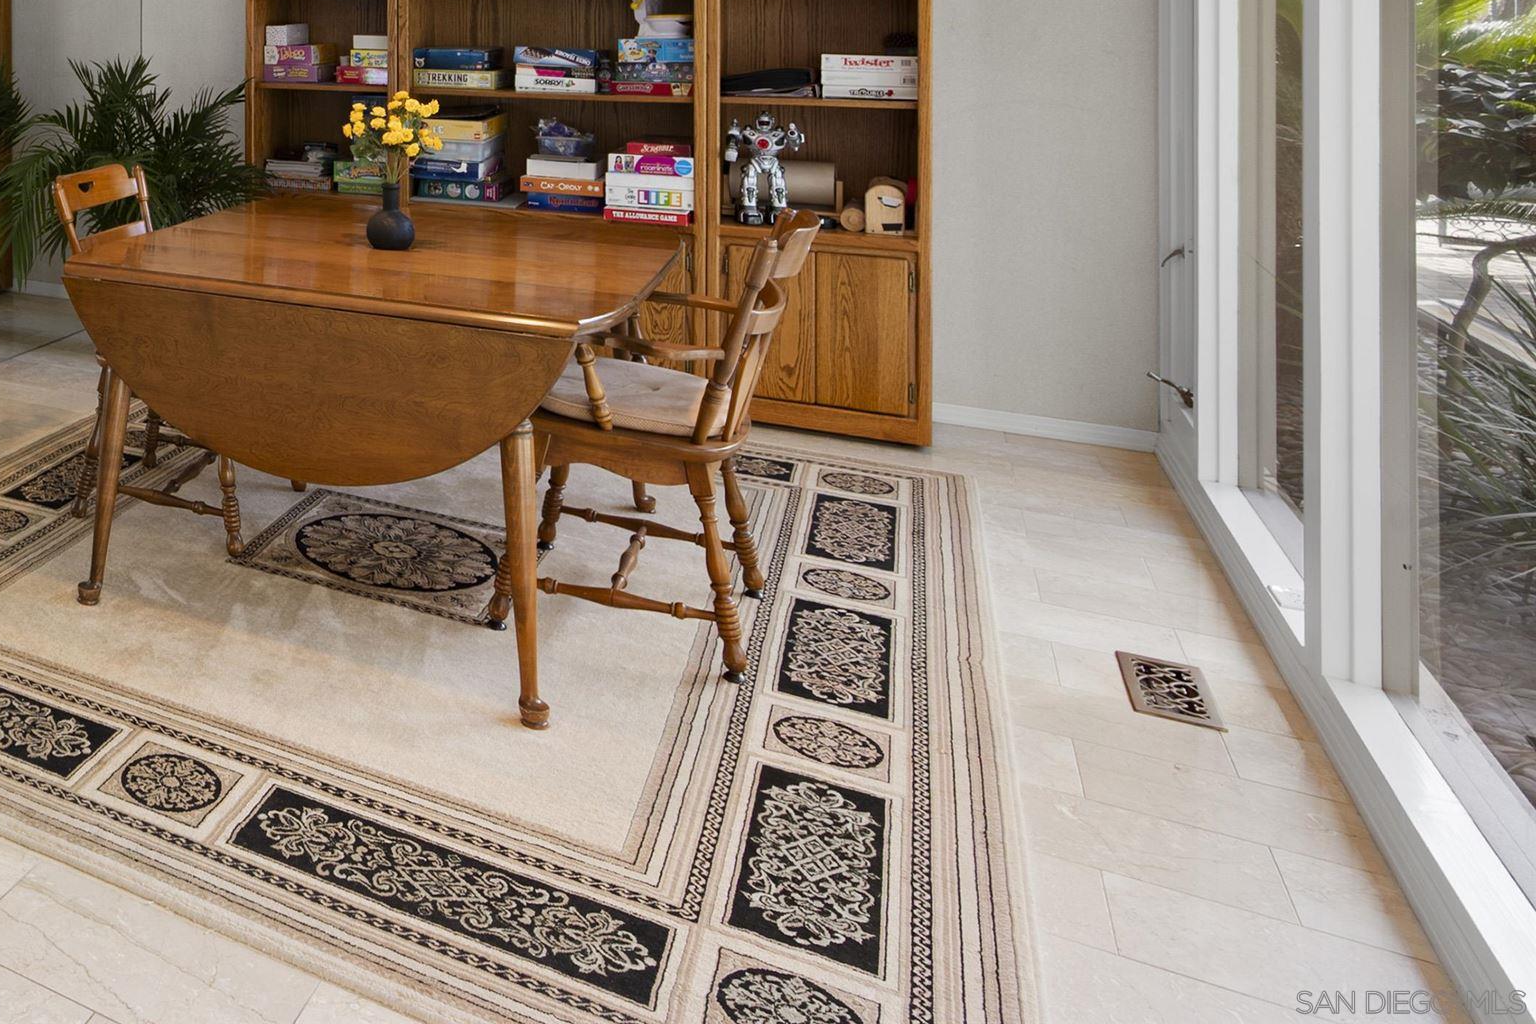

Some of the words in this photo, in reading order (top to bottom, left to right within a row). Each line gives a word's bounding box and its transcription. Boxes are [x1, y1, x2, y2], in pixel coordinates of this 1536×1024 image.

[841, 57, 895, 67] Twister
[427, 72, 468, 83] TREKKING
[535, 78, 564, 87] SORRY!
[638, 190, 682, 207] LIFE
[625, 212, 659, 221] ALLOWANCE
[660, 214, 678, 222] GAME
